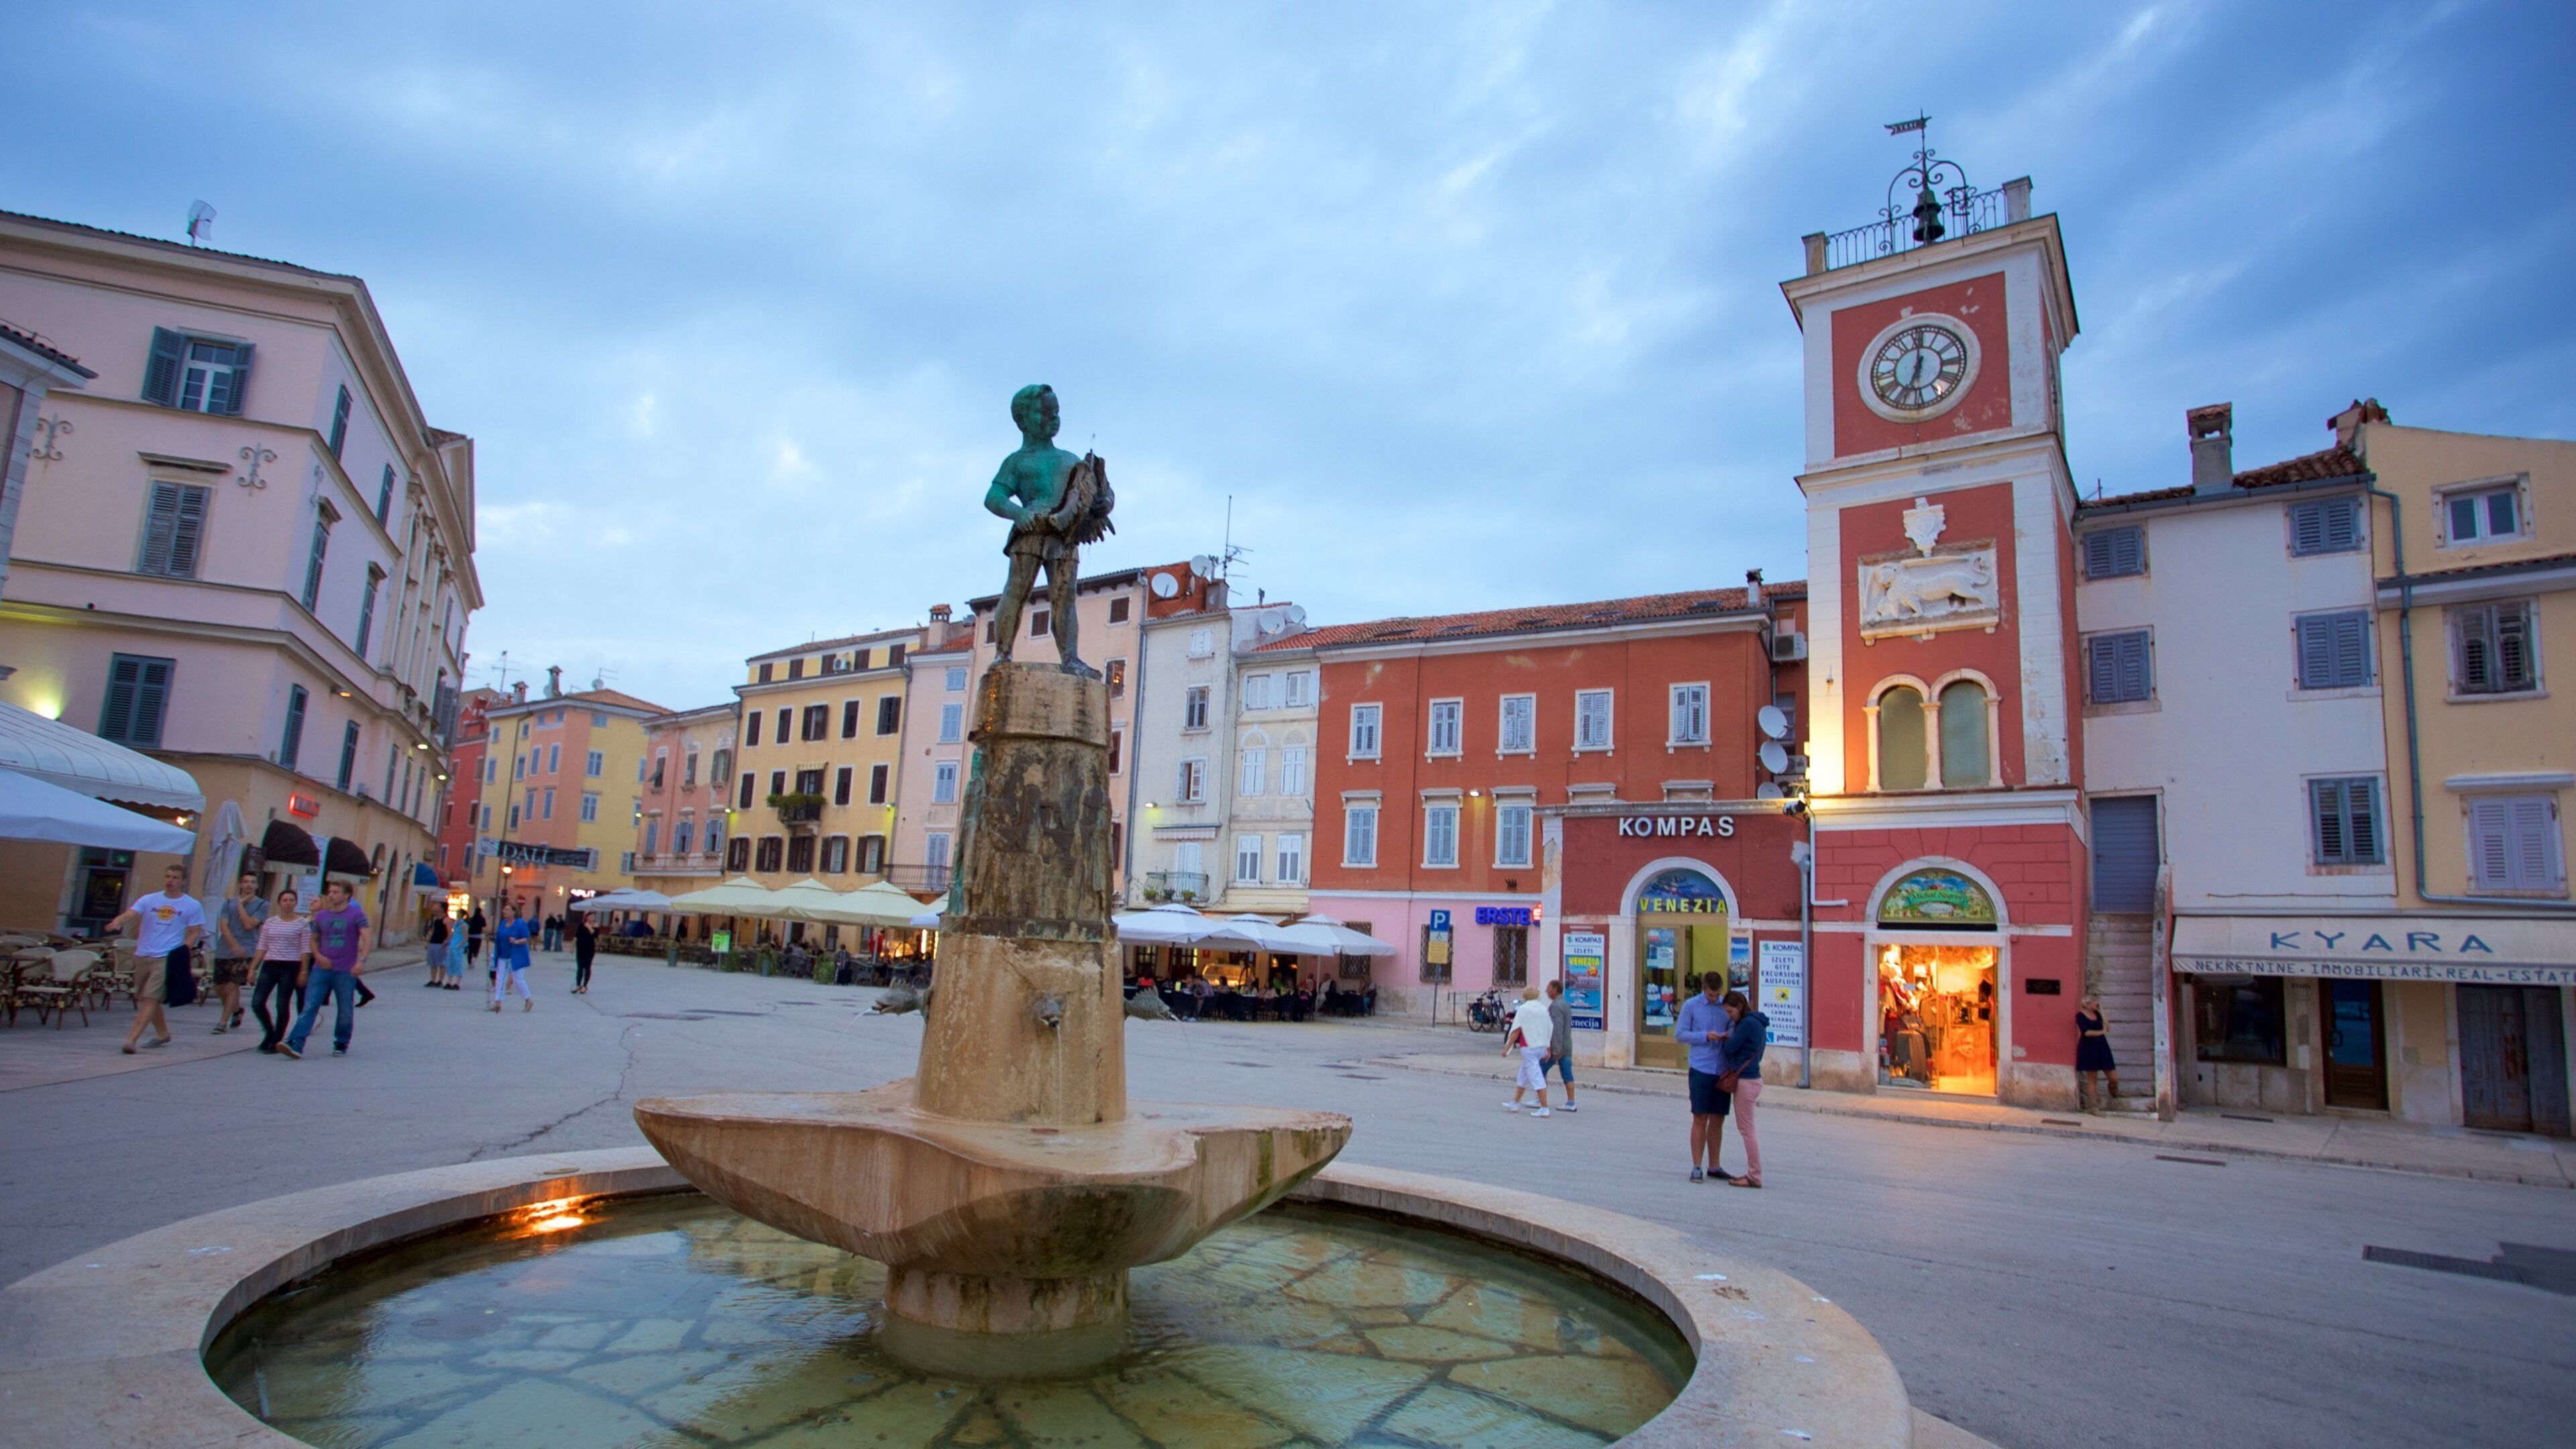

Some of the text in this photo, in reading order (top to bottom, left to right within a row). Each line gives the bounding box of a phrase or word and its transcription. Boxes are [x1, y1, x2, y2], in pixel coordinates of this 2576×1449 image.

[1619, 816, 1735, 837] KOMPAS
[504, 844, 550, 863] DALI
[1911, 892, 1935, 900] Michal
[1640, 898, 1727, 913] VENEZIA
[1434, 912, 1446, 929] P
[1476, 907, 1530, 925] ERSTE
[2271, 930, 2493, 953] KYARA
[1569, 956, 1600, 966] VENEZIA
[2196, 960, 2295, 973] NEKRETNINE
[2311, 963, 2431, 977] IMMOBILIARI
[1571, 1018, 1599, 1029] enecija
[1776, 1034, 1799, 1042] phone
